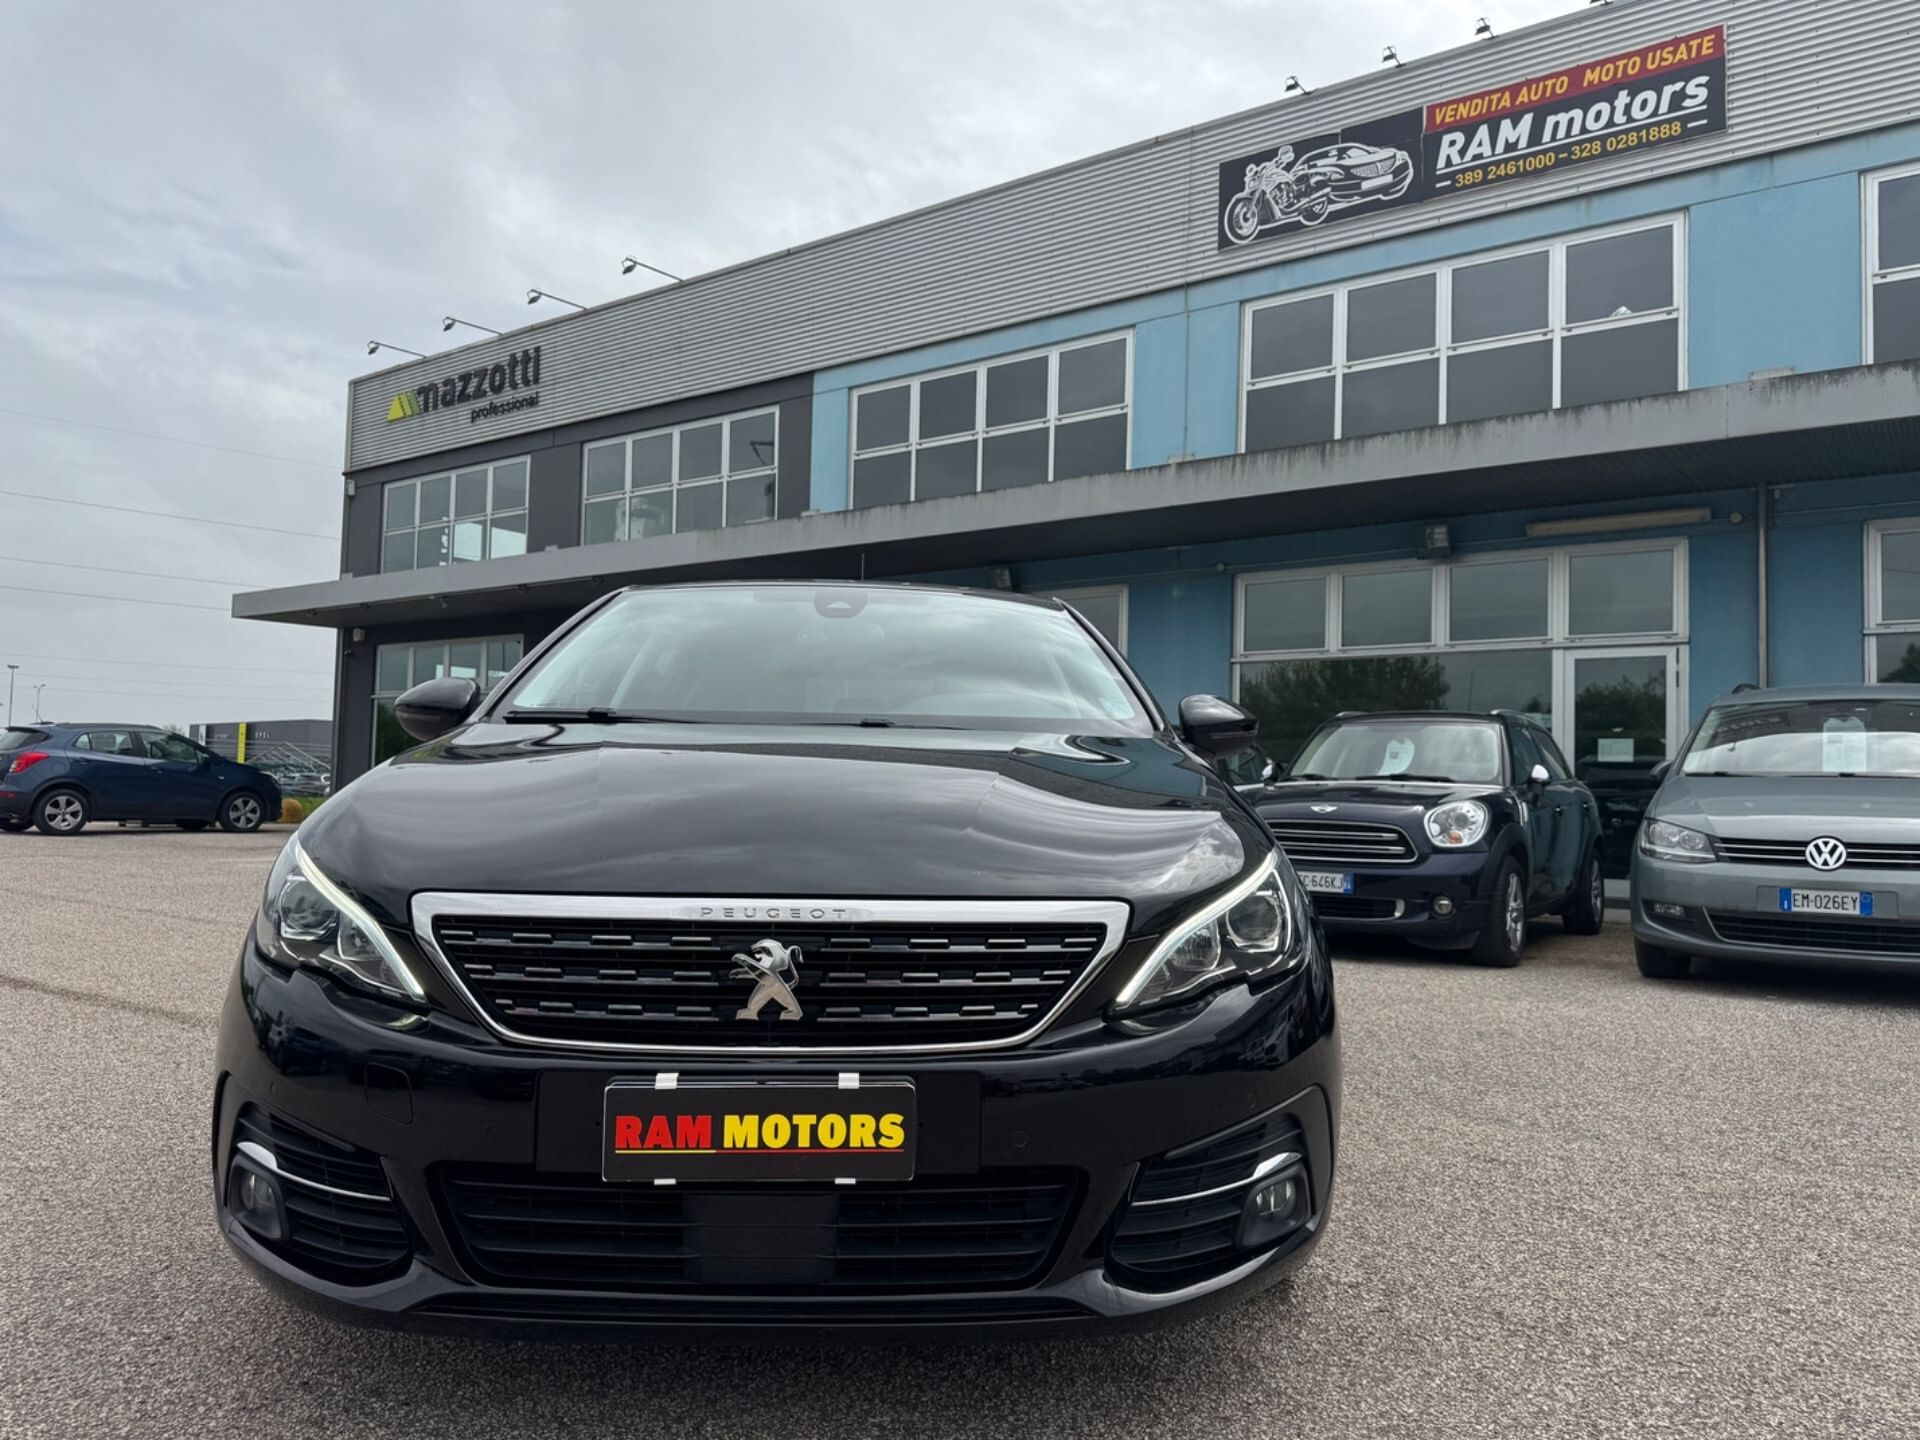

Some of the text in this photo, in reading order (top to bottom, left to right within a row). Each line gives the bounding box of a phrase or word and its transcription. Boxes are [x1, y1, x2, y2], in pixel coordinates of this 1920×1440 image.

[1435, 34, 1716, 125] VENDITA AUTO MOTO USATE
[1436, 75, 1710, 169] RAM motors
[1455, 165, 1483, 187] 389
[1487, 151, 1556, 180] 2461000
[1571, 139, 1601, 160] 328
[1606, 121, 1682, 151] 0281888
[417, 346, 541, 412] mazzotti
[470, 392, 540, 423] professional
[700, 906, 846, 920] PEUGEOT
[615, 1113, 905, 1149] RAM MOTORS
